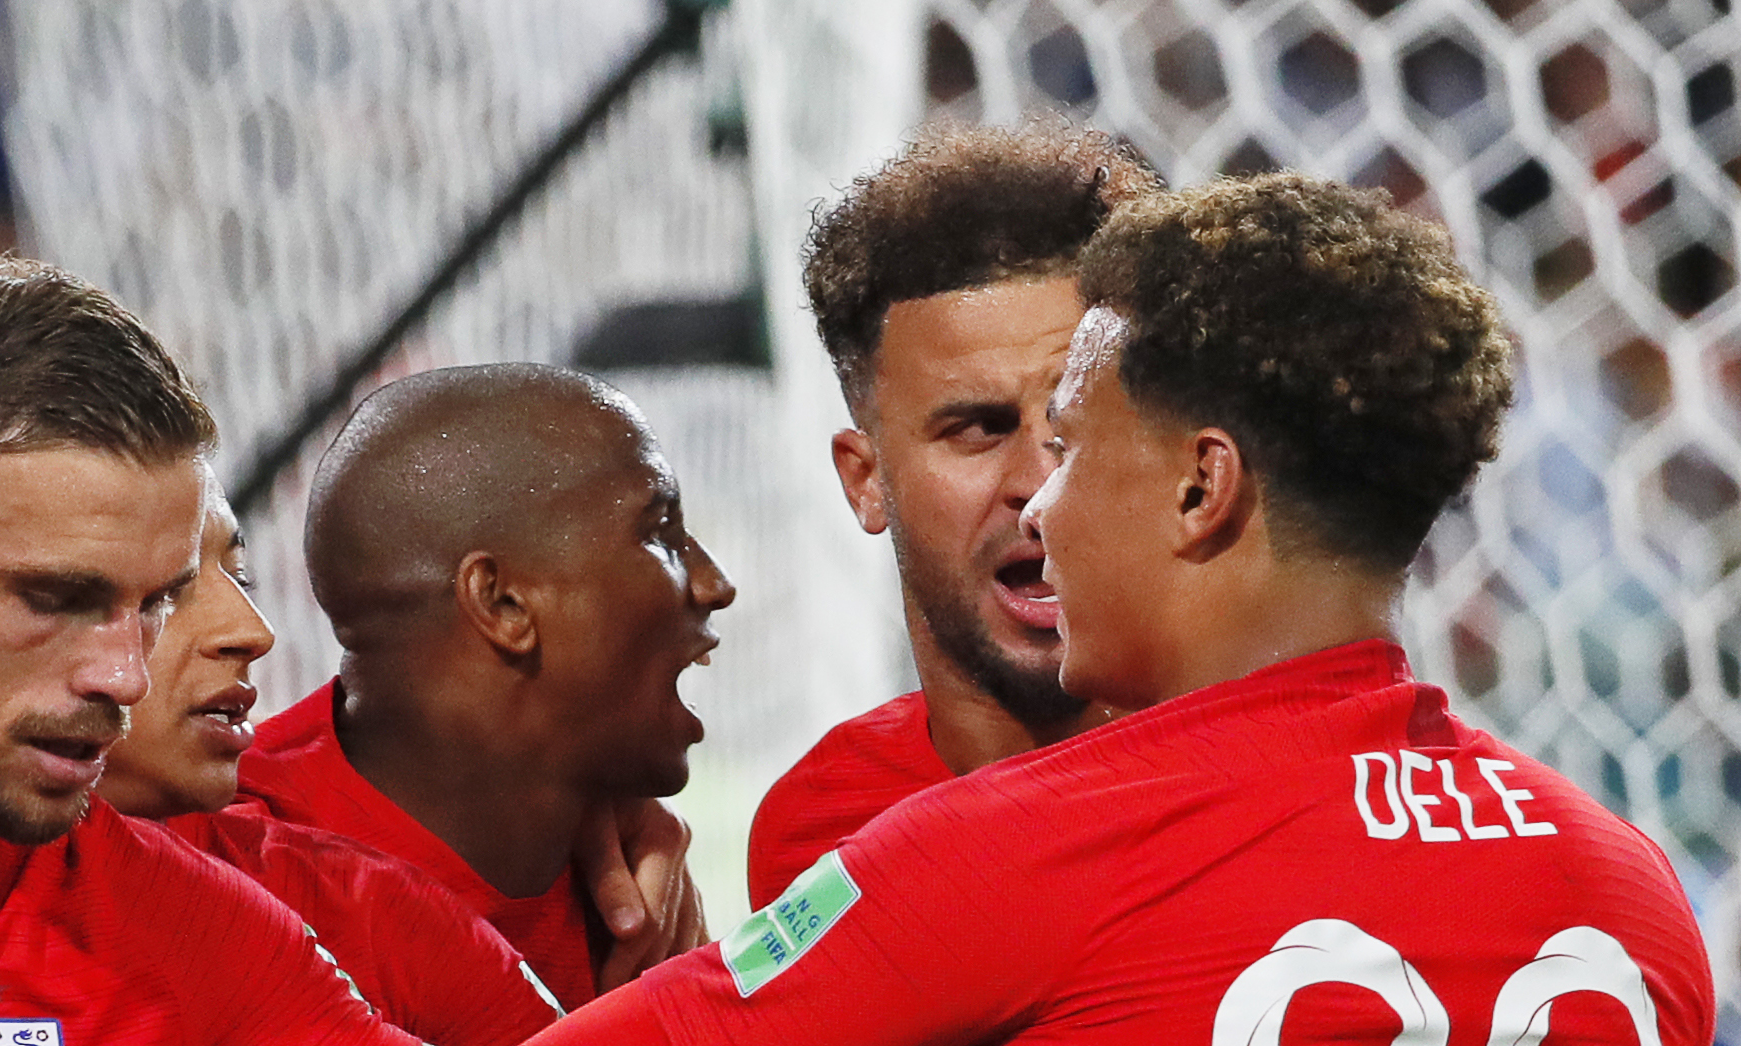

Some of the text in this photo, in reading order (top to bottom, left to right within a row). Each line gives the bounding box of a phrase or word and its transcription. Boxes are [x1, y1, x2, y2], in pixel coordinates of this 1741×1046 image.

[1351, 748, 1559, 843] DELE
[778, 899, 809, 942] BALL
[761, 931, 787, 965] FIFA
